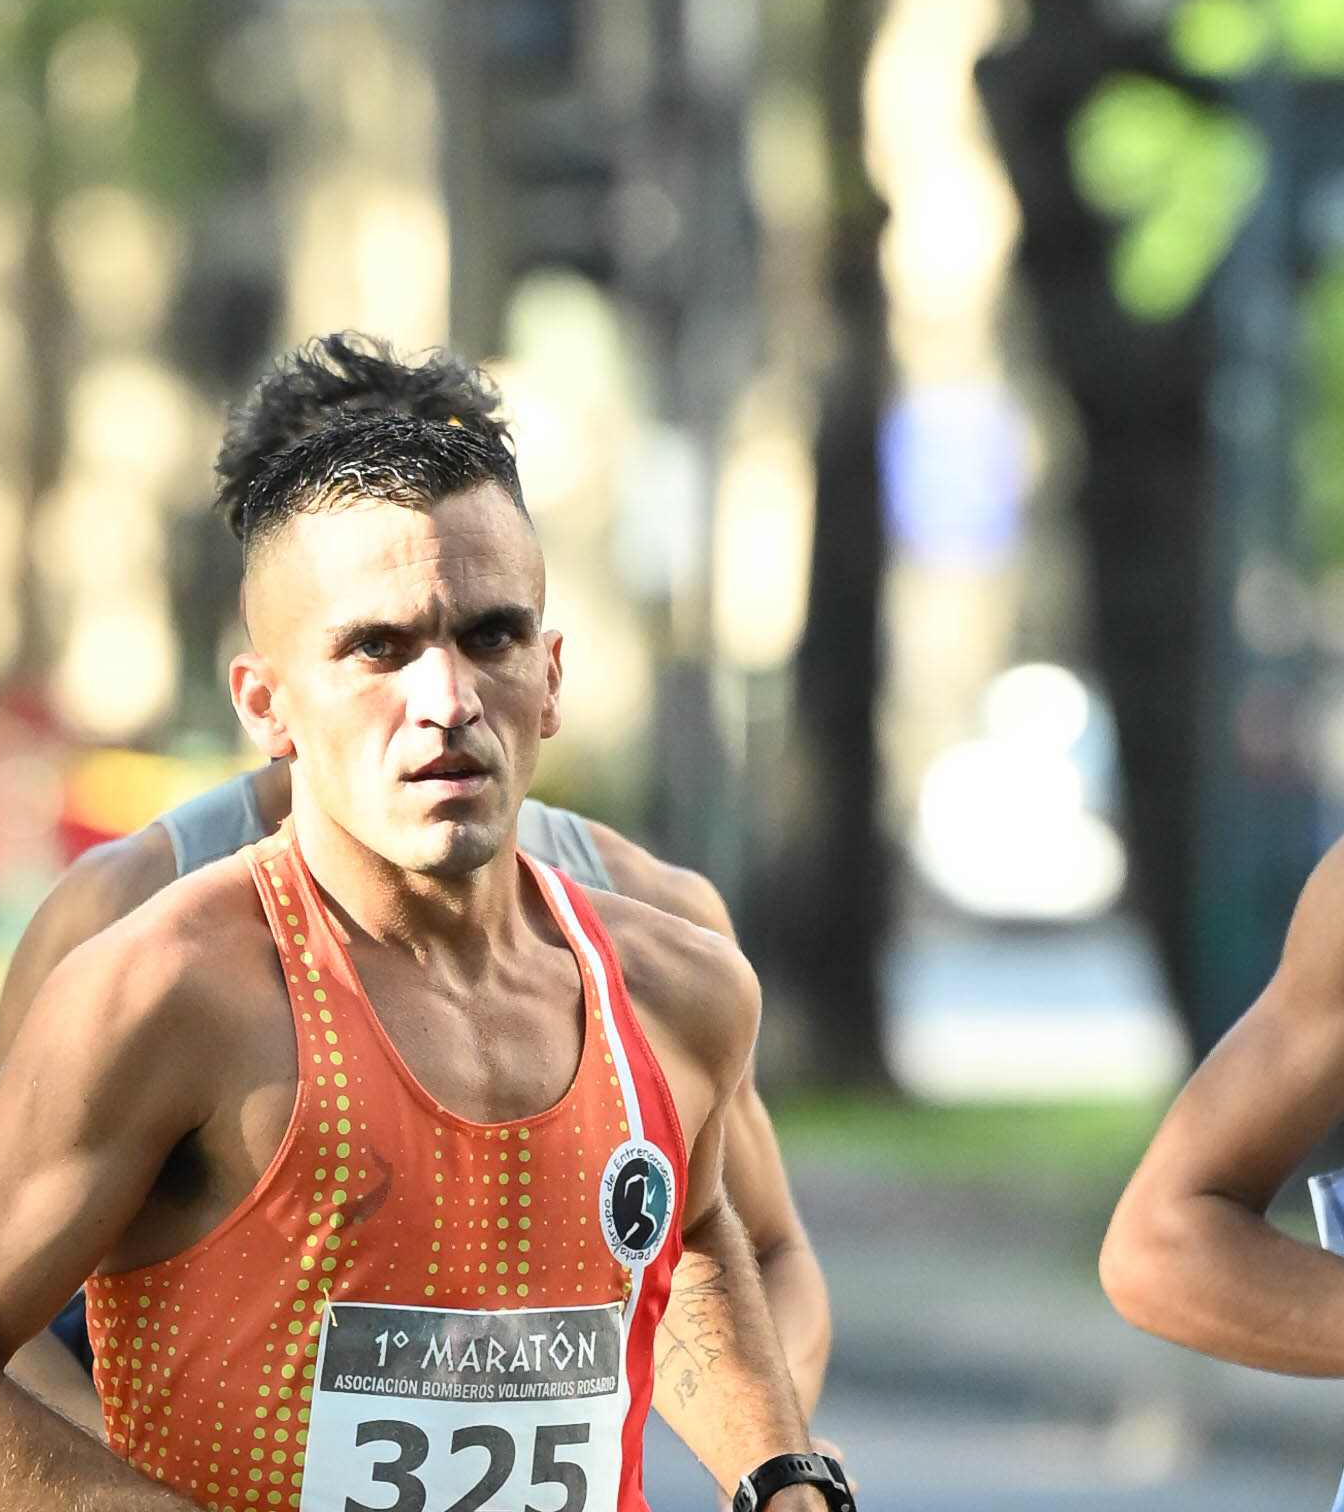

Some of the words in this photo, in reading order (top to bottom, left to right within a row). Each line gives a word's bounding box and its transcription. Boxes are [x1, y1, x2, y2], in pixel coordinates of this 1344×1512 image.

[603, 1173, 616, 1192] de
[420, 1320, 596, 1374] MARATÓN
[334, 1373, 418, 1396] ASOCIACIÓN
[422, 1382, 495, 1400] BOMBEROS
[497, 1381, 575, 1399] VOLUNTARIOS
[576, 1375, 617, 1396] ROSARIO
